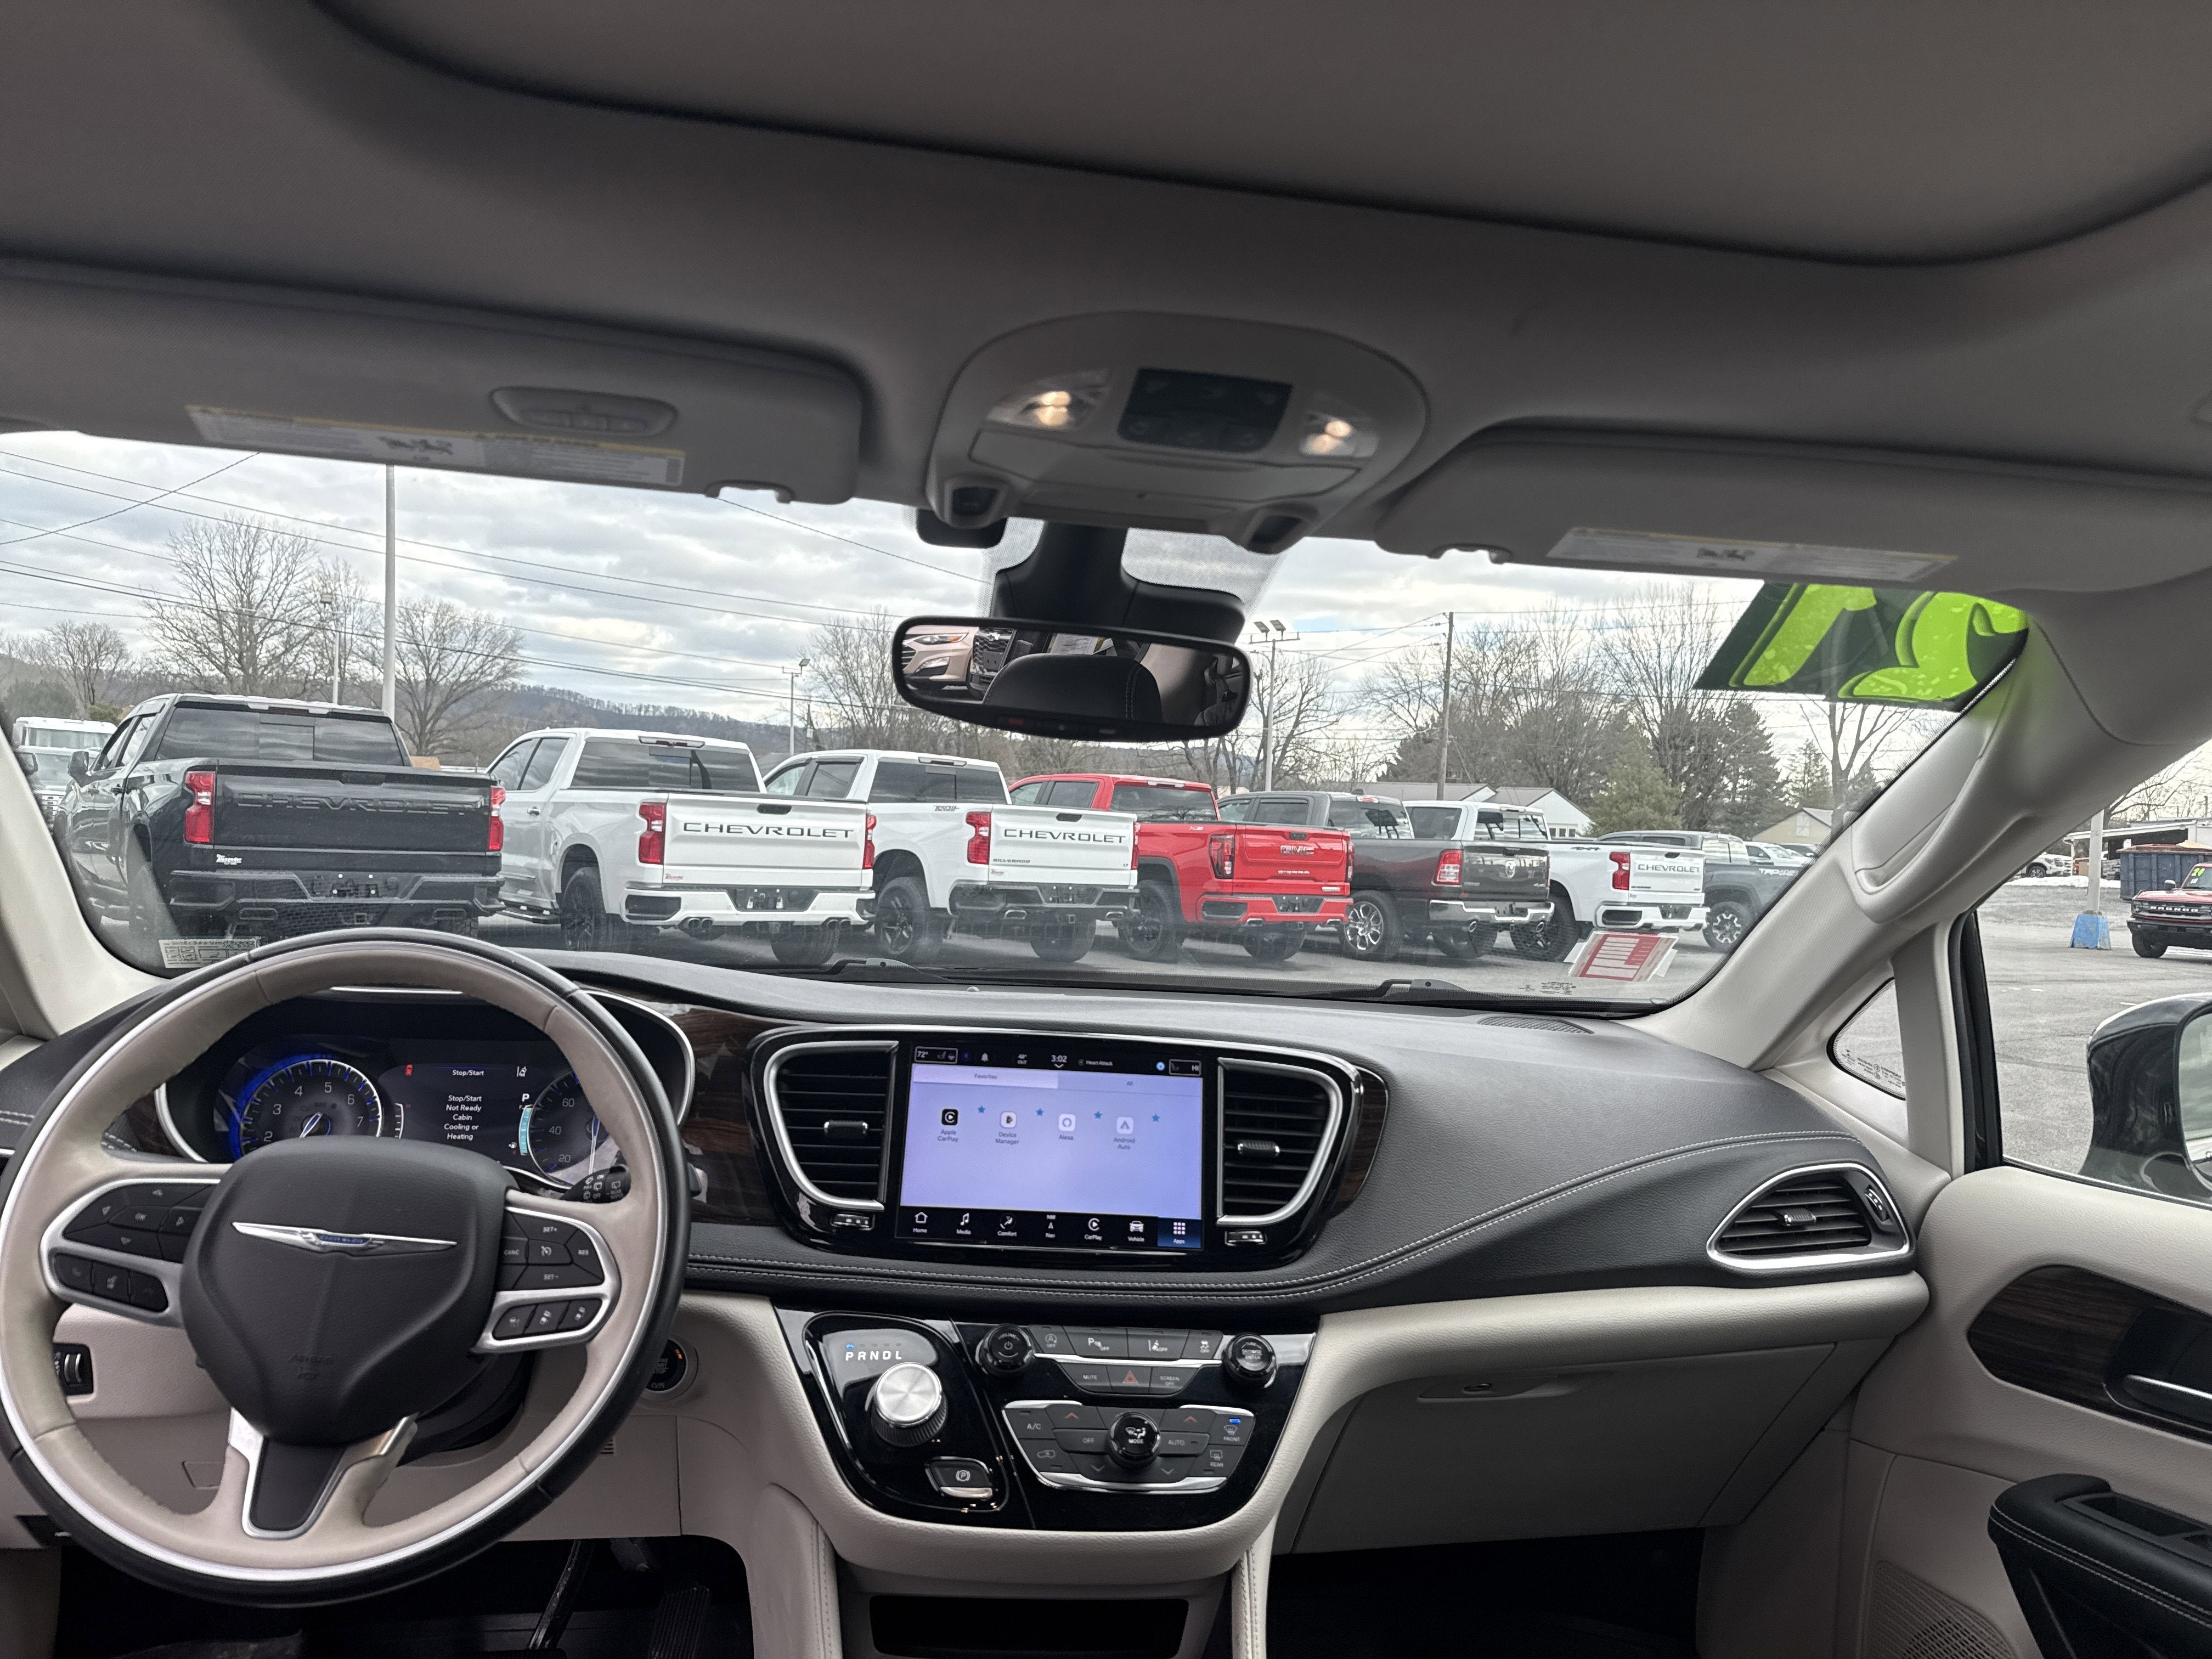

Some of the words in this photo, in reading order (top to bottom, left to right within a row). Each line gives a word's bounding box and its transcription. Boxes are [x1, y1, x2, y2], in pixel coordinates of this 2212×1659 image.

[238, 793, 488, 816] CHEVROLET
[684, 822, 854, 838] CHEVROLET
[1004, 829, 1126, 843] CHEVROLET
[1280, 845, 1314, 856] GMC
[1638, 864, 1701, 873] CHEVROLET
[1051, 1054, 1068, 1063] 3:02
[294, 1086, 303, 1096] 4
[324, 1082, 332, 1093] 5
[347, 1094, 355, 1105] 6
[522, 1093, 530, 1102] P
[562, 1098, 575, 1107] 60
[273, 1104, 281, 1115] 3
[357, 1116, 364, 1127] 7
[549, 1126, 562, 1135] 40
[264, 1131, 273, 1142] 2
[558, 1154, 571, 1163] 20
